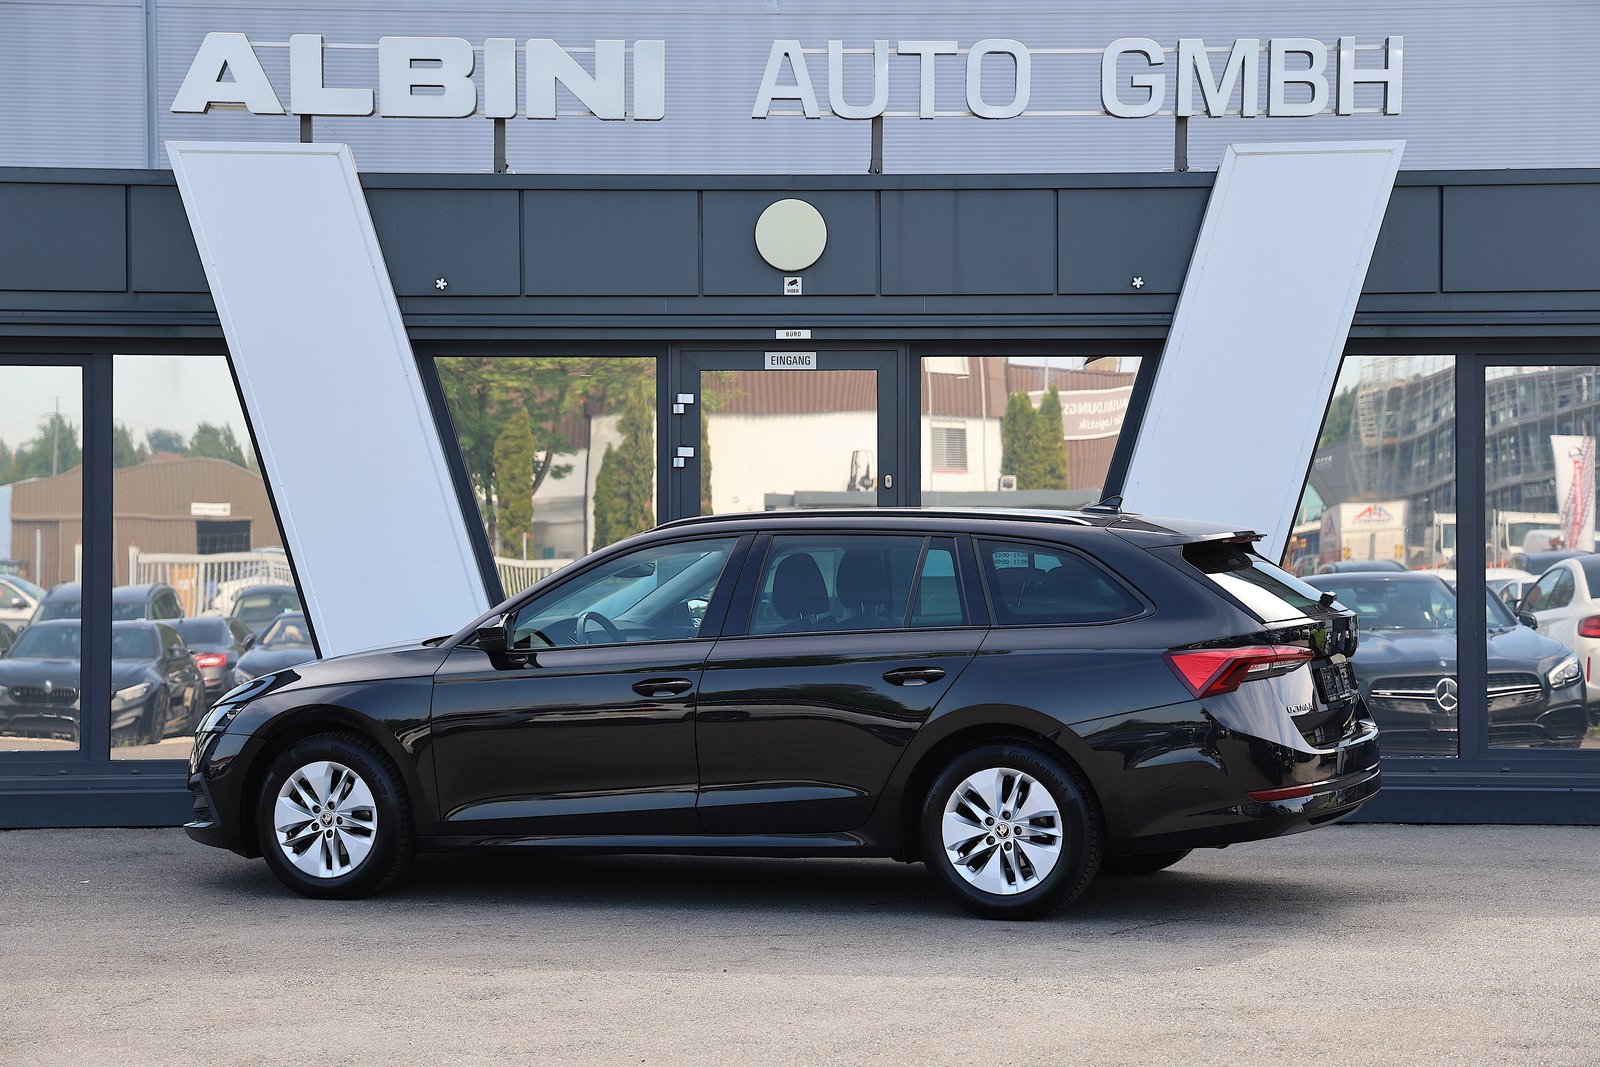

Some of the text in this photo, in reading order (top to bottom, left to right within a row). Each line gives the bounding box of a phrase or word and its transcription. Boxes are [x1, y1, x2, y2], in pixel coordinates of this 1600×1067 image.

[170, 32, 1404, 121] ALBINI AUTO GMBH
[770, 355, 811, 366] EINGANG
